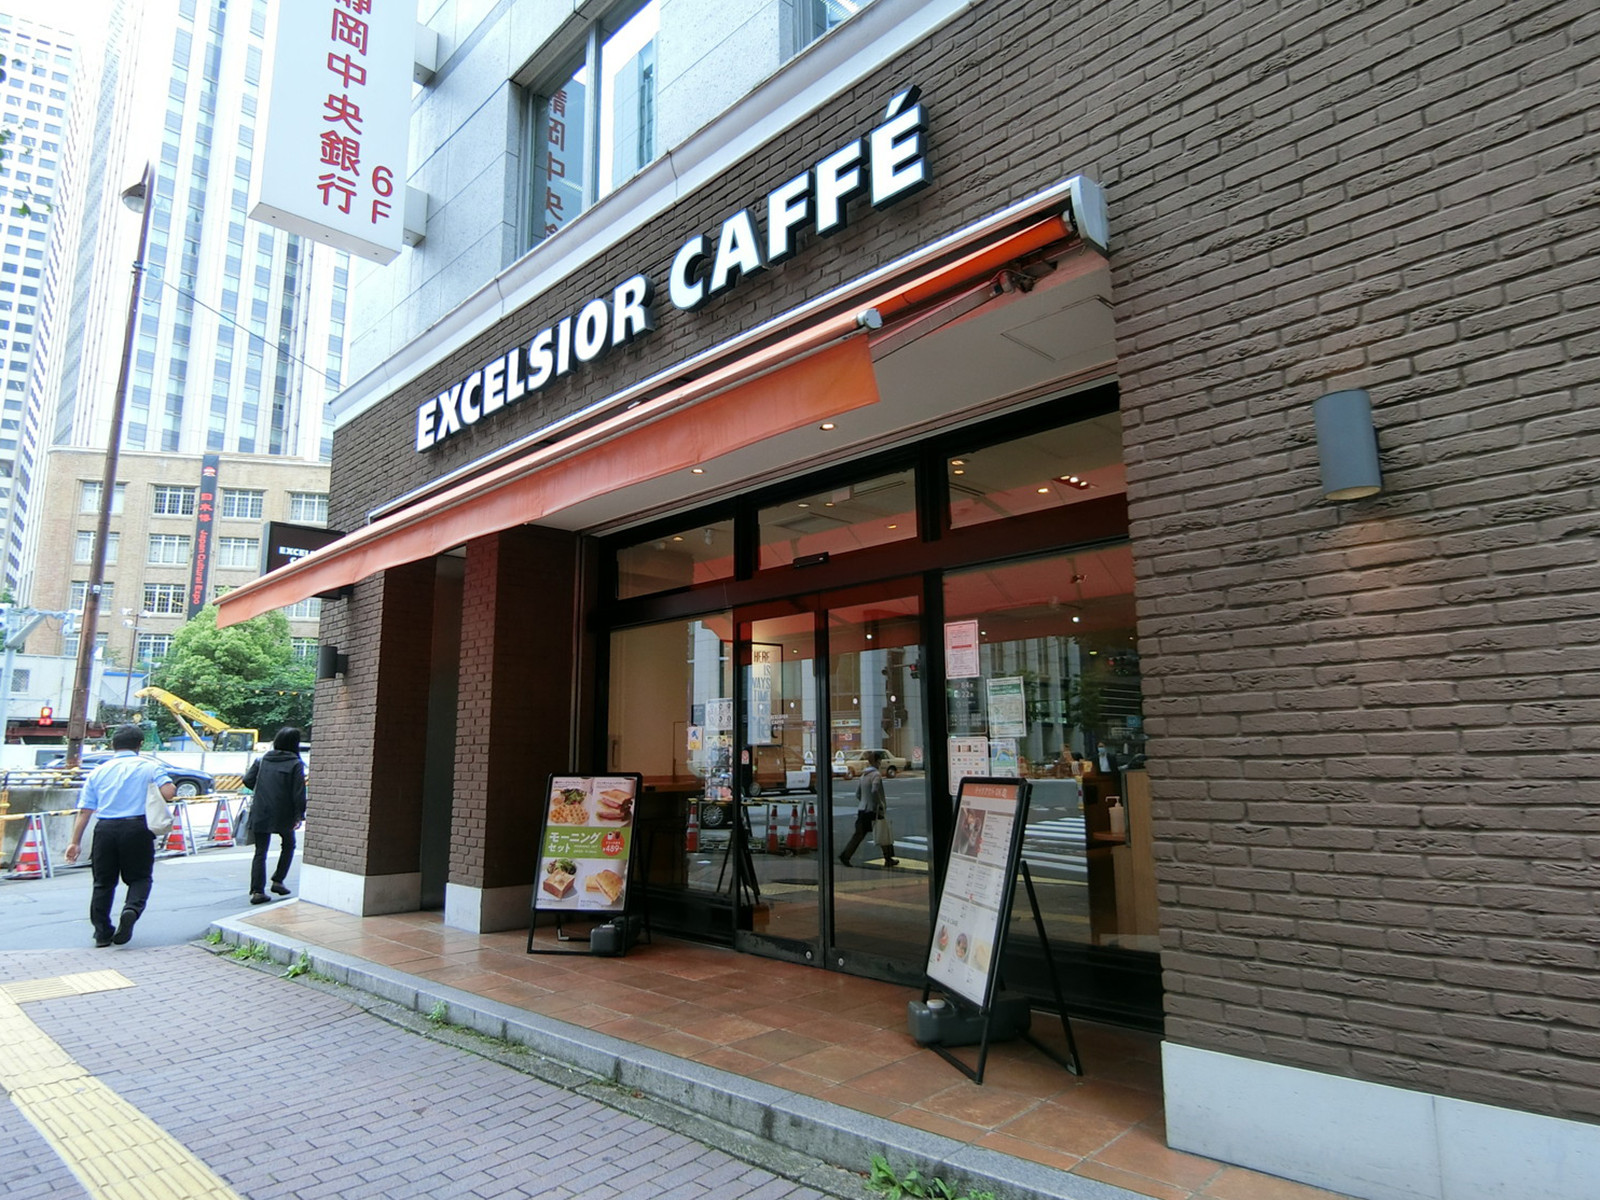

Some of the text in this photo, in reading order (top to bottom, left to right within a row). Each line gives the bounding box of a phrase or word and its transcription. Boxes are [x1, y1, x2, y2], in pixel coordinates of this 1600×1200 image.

[371, 165, 394, 225] 6F
[416, 84, 929, 453] EXCELSIOR CAFFÉ
[193, 530, 208, 604] Japan Cultural Expo
[548, 842, 571, 853] セット
[549, 832, 602, 844] モーニング
